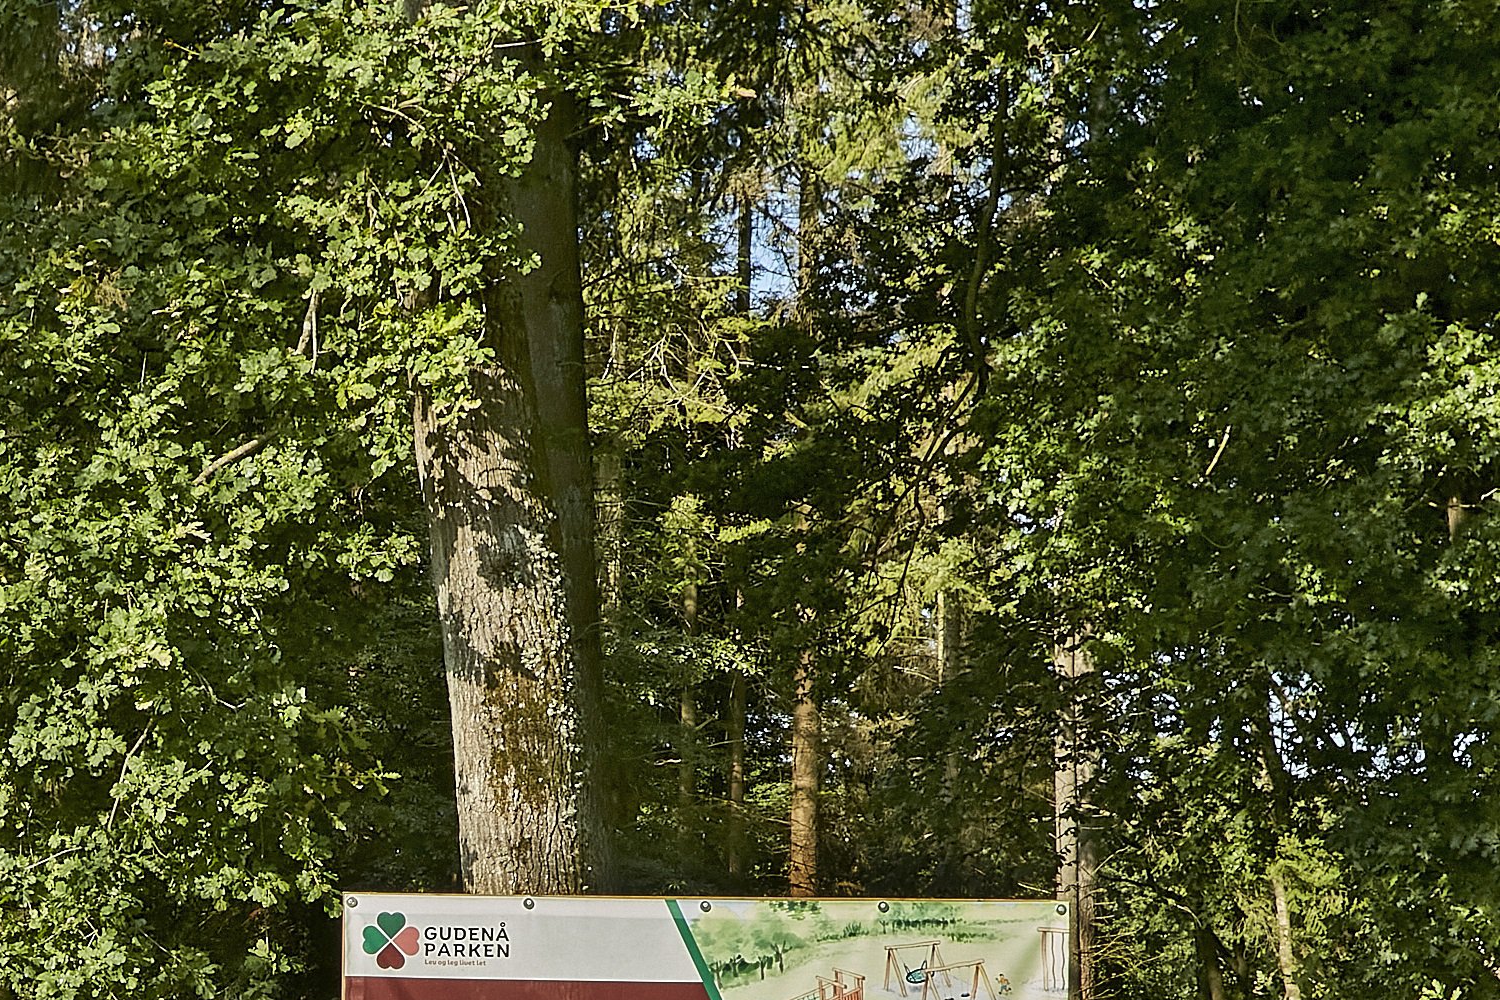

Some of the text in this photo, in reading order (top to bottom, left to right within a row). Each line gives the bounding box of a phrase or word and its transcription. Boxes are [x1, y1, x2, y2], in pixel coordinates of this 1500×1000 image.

[424, 921, 510, 942] GUDENÅ
[424, 943, 510, 958] PARKEN
[447, 959, 458, 967] leg
